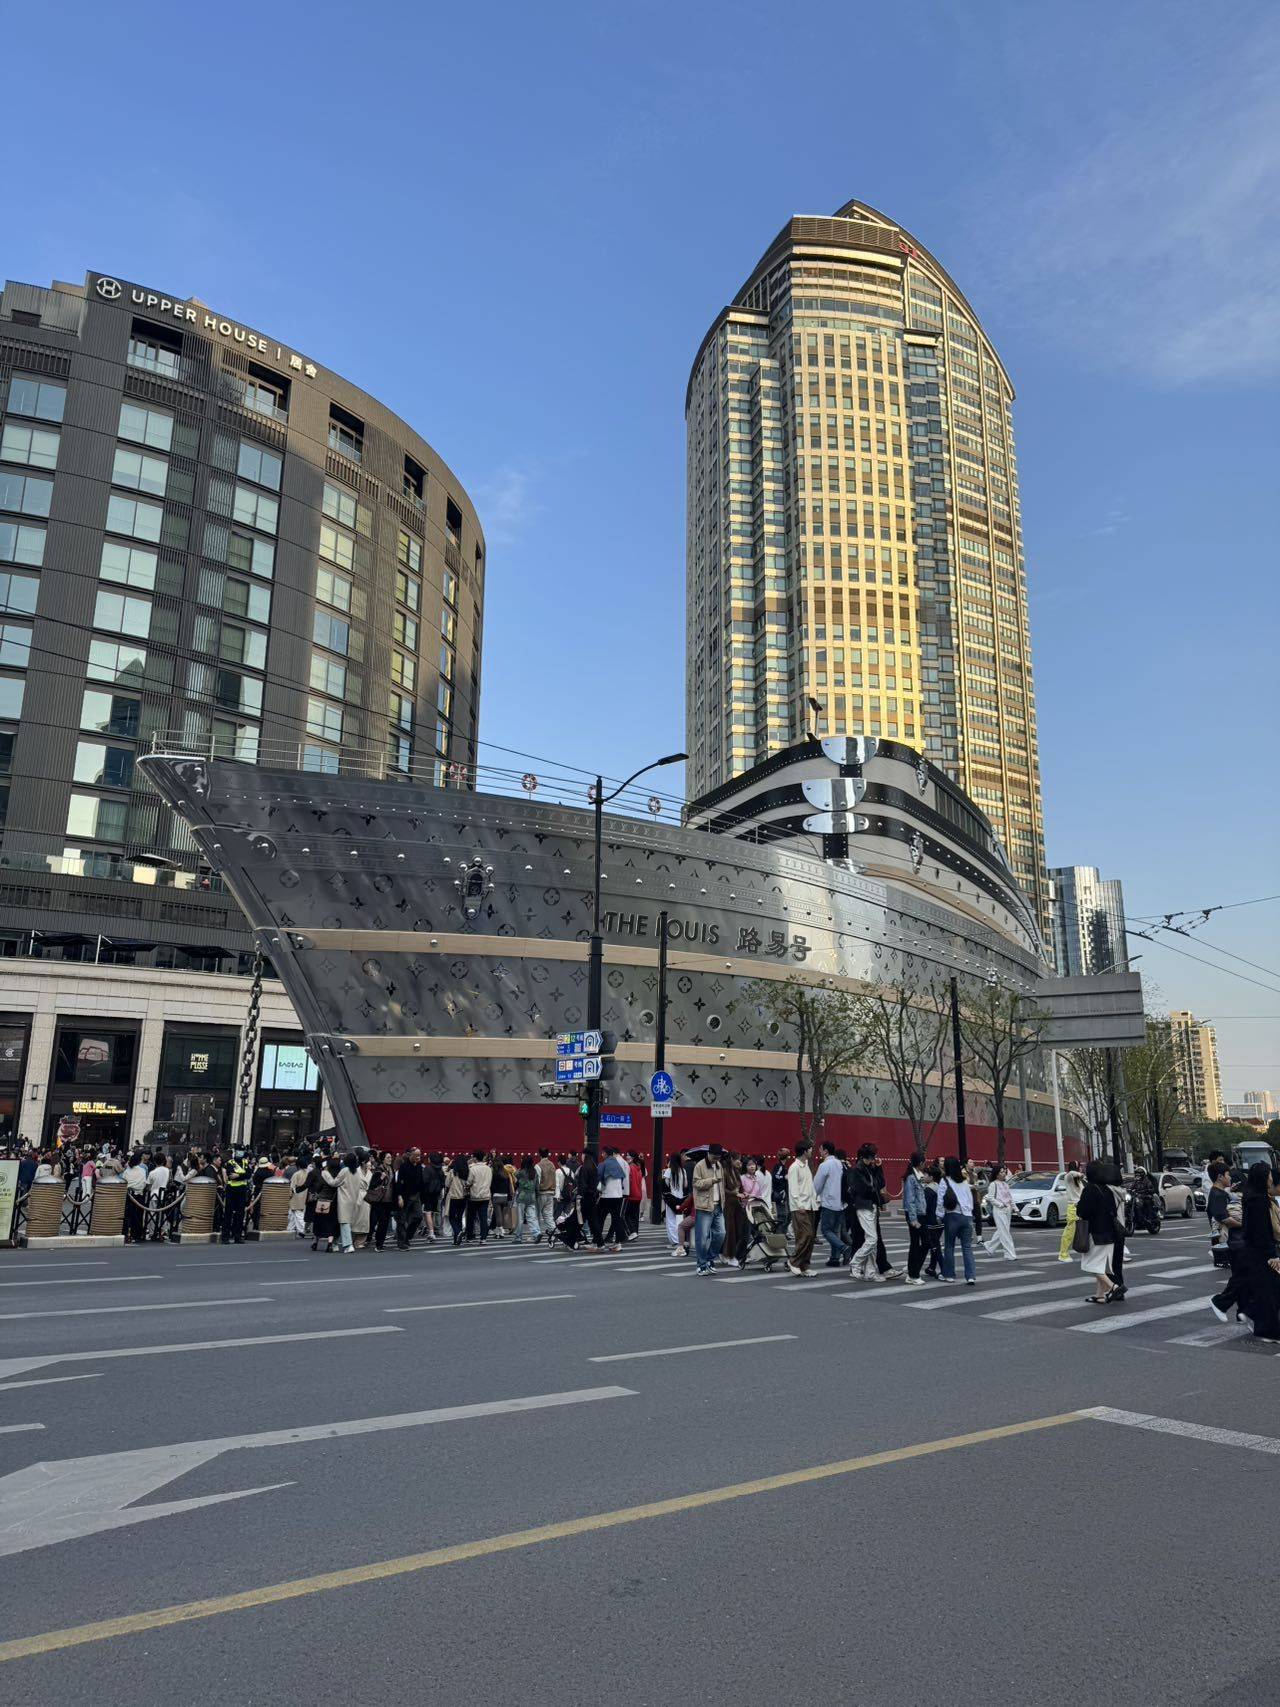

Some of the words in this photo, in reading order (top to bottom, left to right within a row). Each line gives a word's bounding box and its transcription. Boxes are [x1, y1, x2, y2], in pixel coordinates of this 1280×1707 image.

[132, 289, 197, 323] UPPER
[204, 315, 268, 353] HOUSE
[604, 910, 649, 935] THE
[735, 926, 812, 962] 路易号
